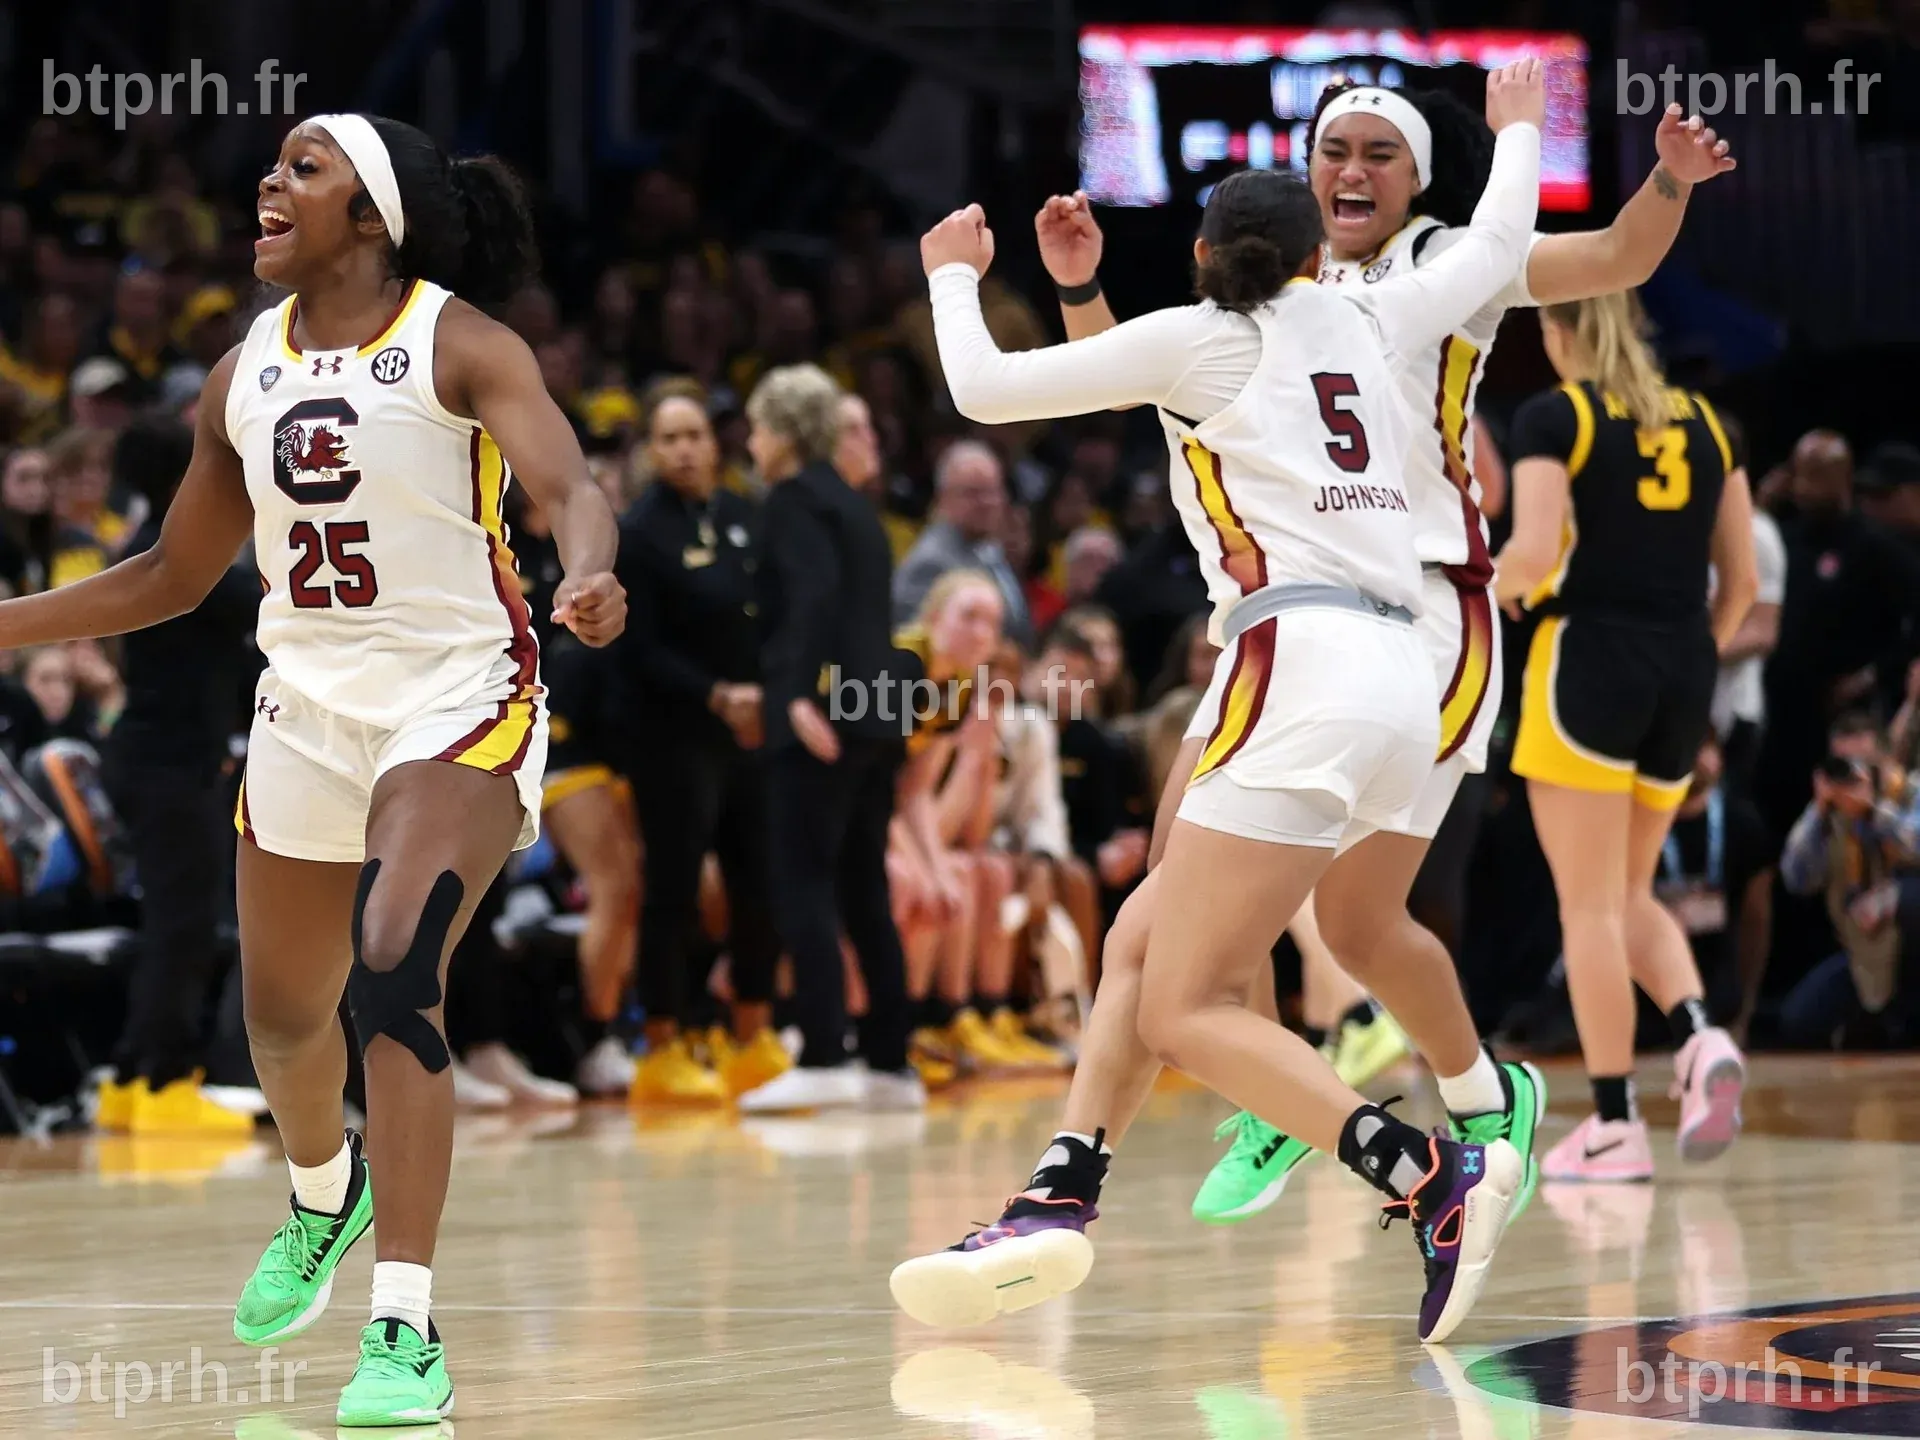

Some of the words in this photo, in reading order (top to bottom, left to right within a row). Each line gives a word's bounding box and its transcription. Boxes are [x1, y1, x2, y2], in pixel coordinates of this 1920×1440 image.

[373, 348, 409, 383] SEC
[1310, 372, 1370, 473] 5
[1314, 484, 1409, 513] JOHNSON
[1635, 426, 1691, 510] 3
[289, 521, 378, 608] 25
